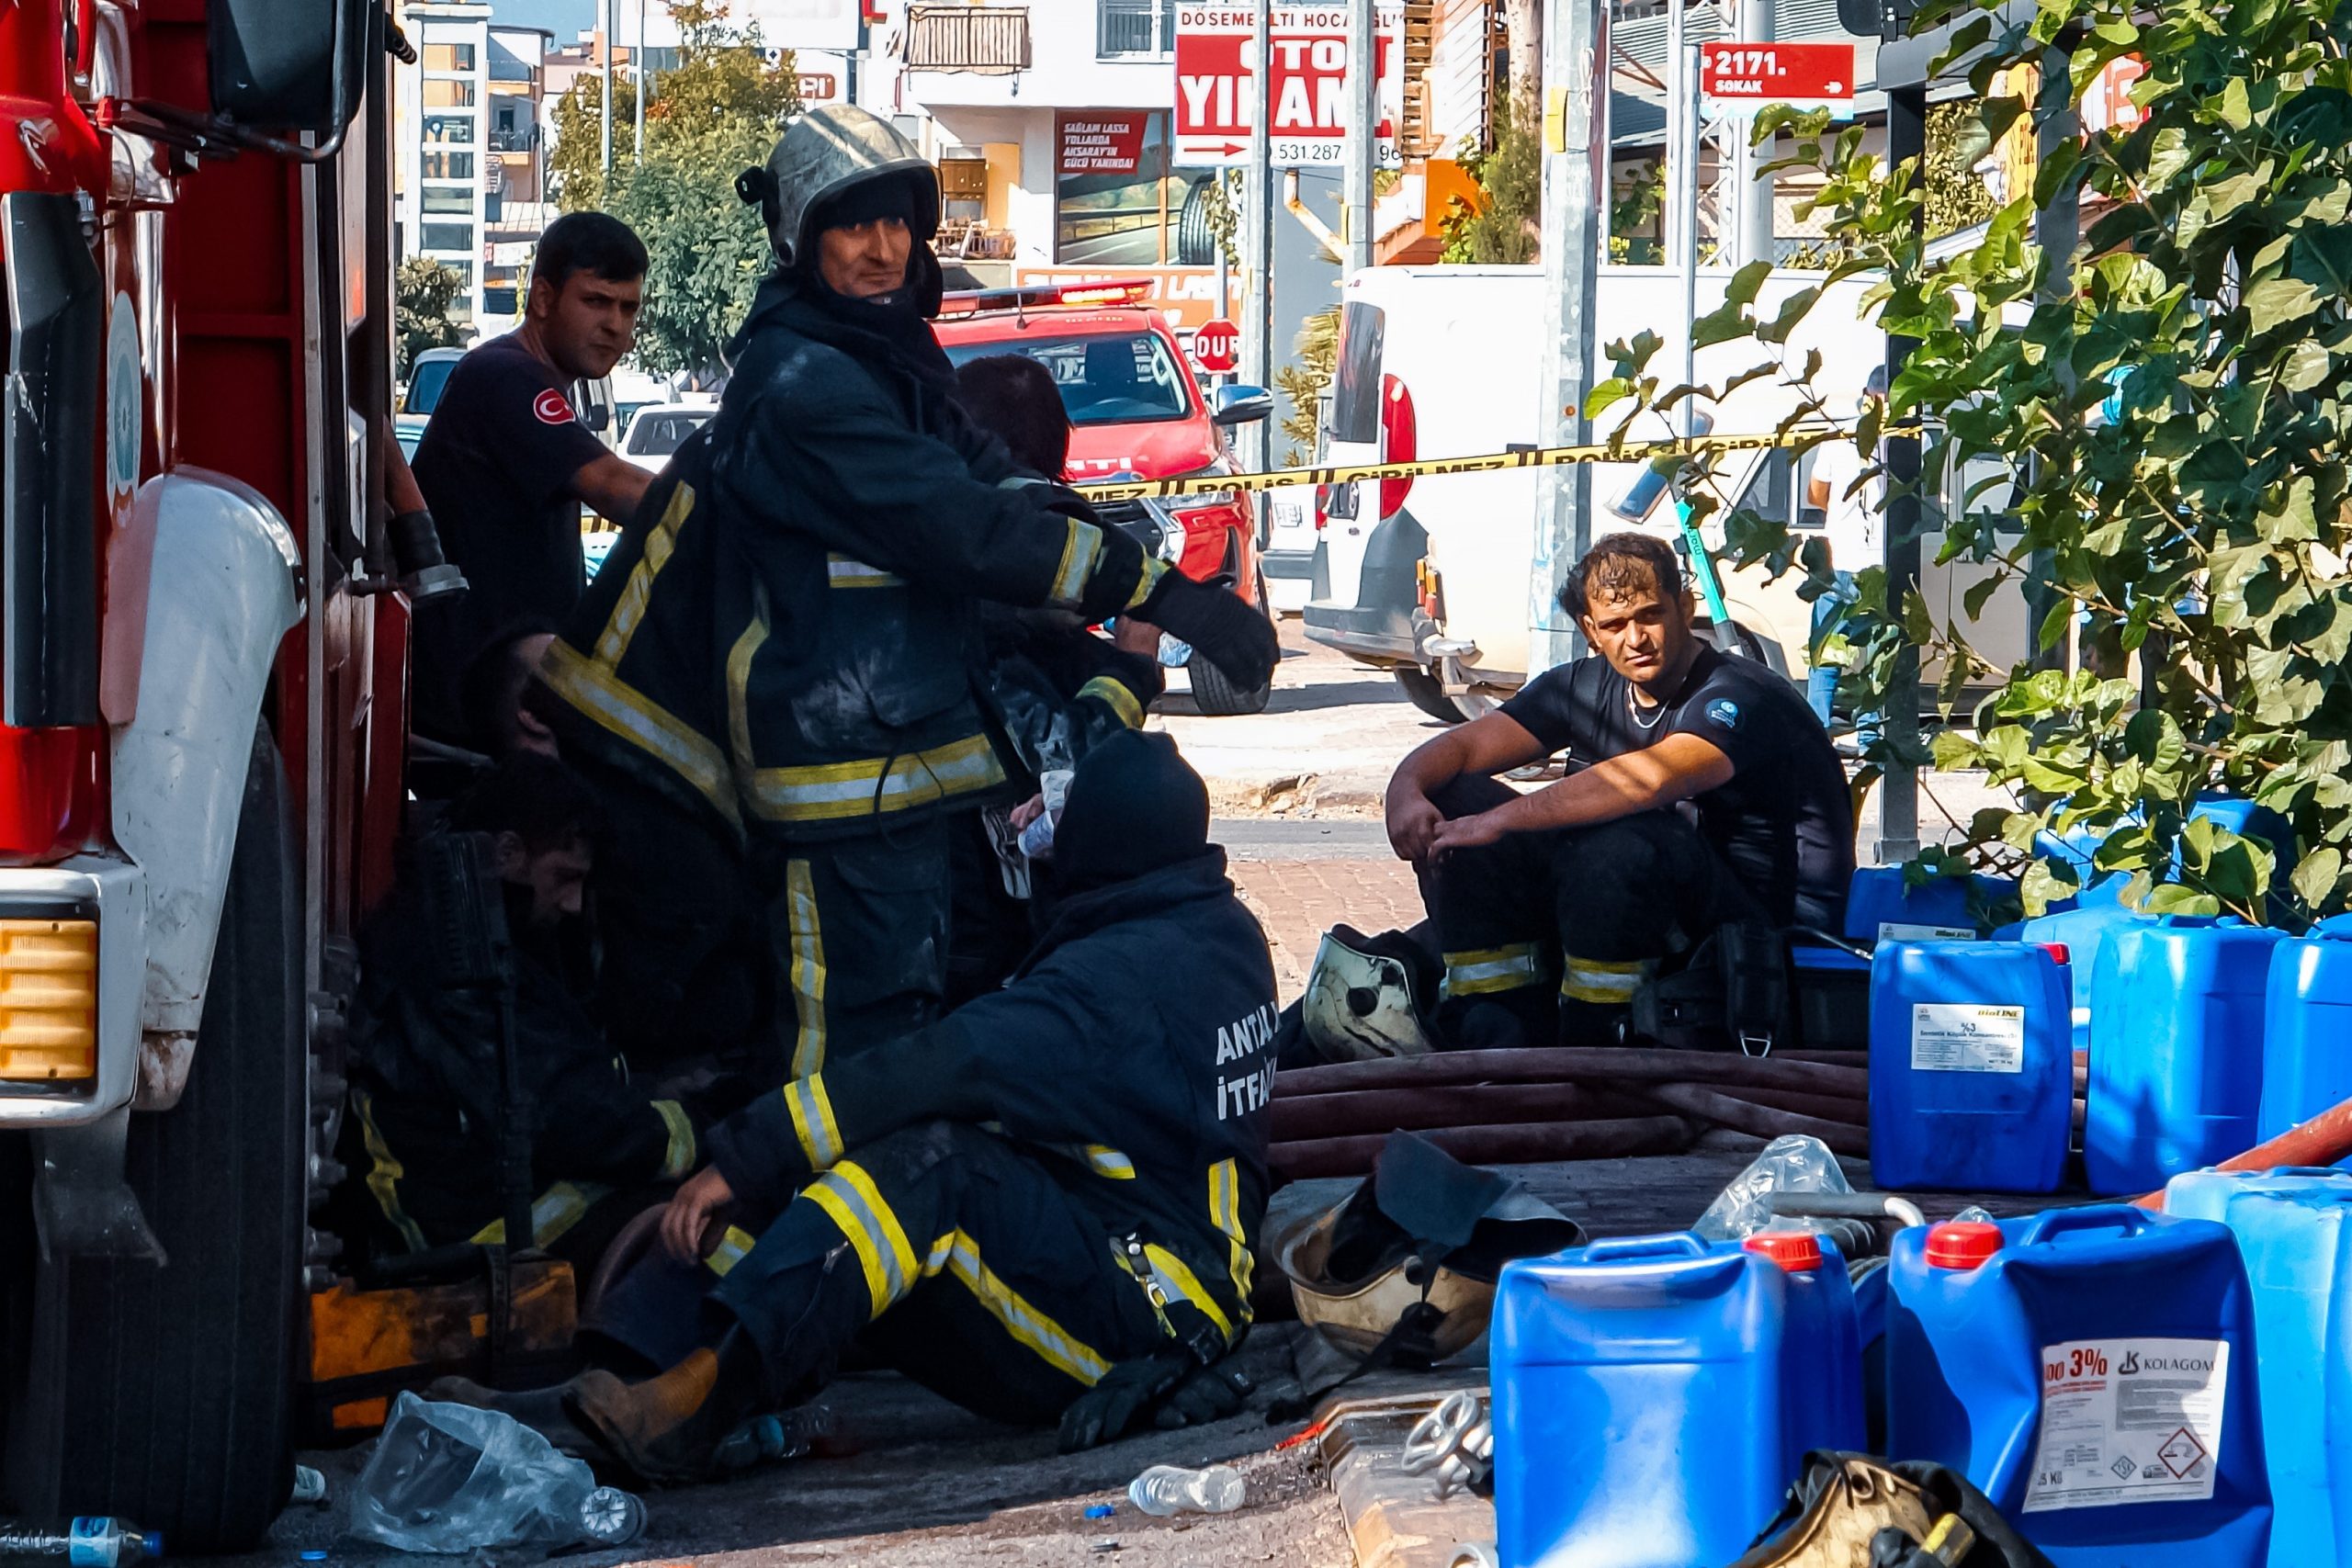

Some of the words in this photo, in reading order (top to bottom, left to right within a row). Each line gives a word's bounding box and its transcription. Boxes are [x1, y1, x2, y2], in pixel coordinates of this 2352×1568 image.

[1715, 51, 1786, 75] 2171.
[1715, 80, 1762, 93] SOKAK
[1197, 335, 1238, 358] DUR
[2070, 1348, 2108, 1377] 3%
